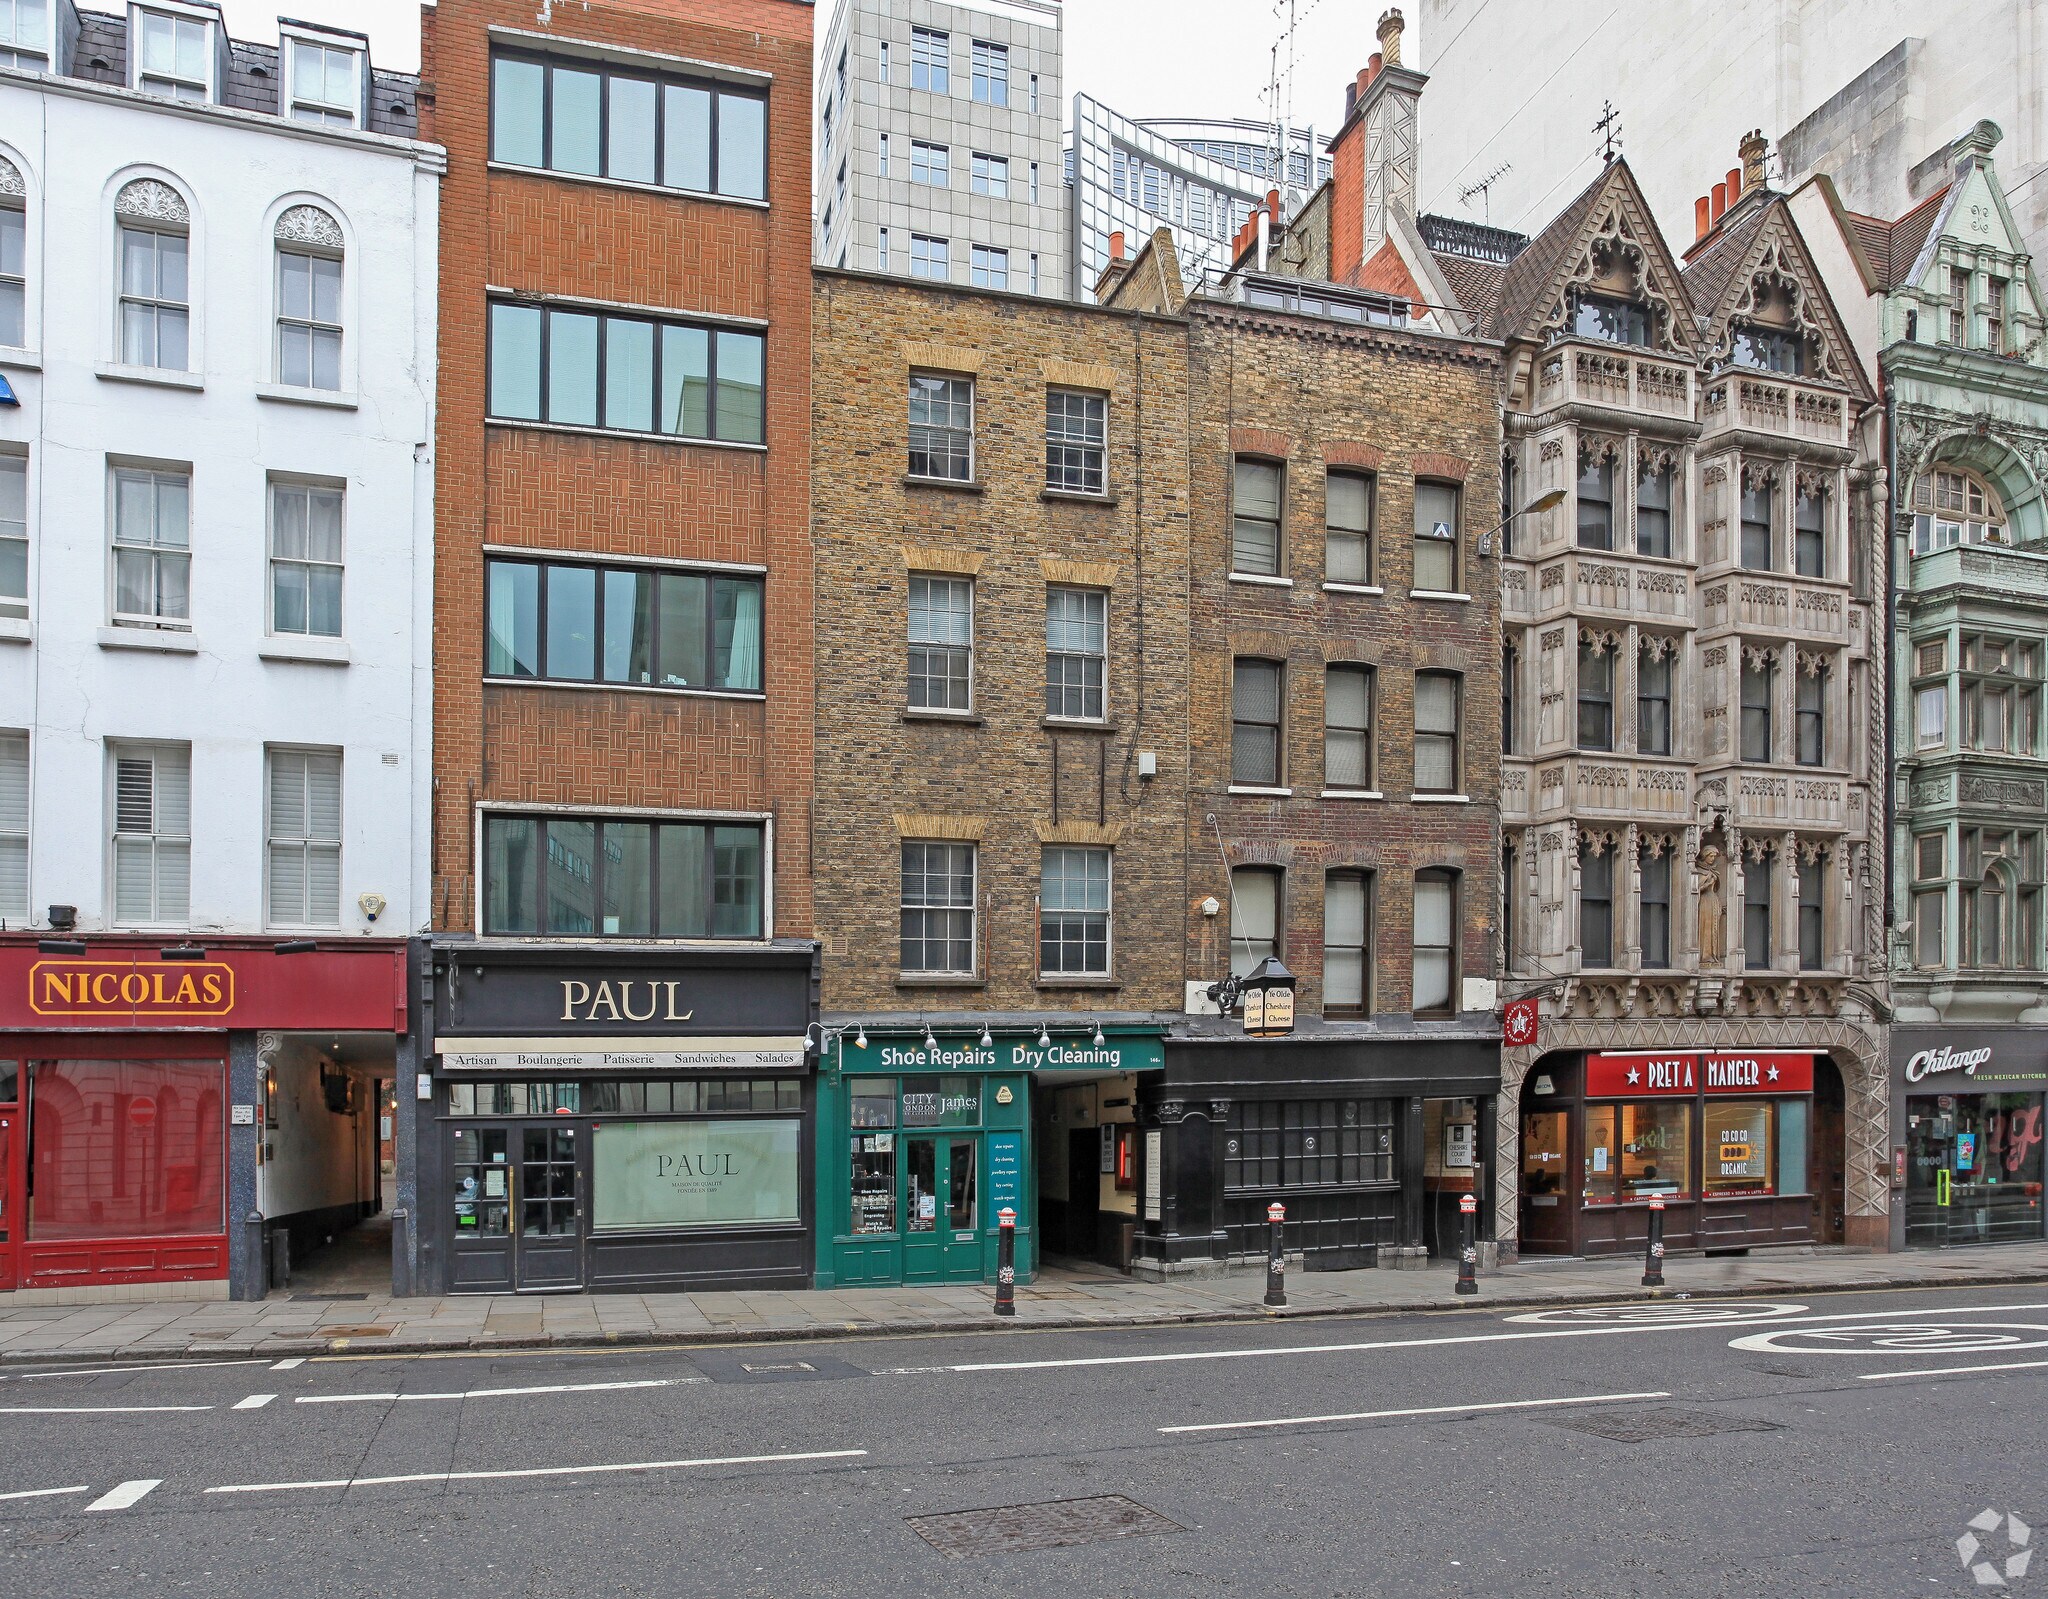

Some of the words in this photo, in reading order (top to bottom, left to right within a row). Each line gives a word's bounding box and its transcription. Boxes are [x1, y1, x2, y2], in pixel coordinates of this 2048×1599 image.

[43, 973, 222, 1004] NICOLAS
[560, 980, 694, 1020] PAUL
[1266, 1002, 1291, 1010] Cheshire
[455, 1055, 497, 1065] Artisan
[517, 1054, 583, 1066] Boulangerie
[603, 1053, 655, 1064] Patisserie
[674, 1053, 736, 1063] Sandwiches
[755, 1053, 794, 1063] Salades
[881, 1047, 926, 1065] Shoe
[930, 1048, 996, 1069] Repairs
[1012, 1047, 1044, 1068] Dry
[1047, 1047, 1120, 1067] Cleaning
[1905, 1045, 1991, 1082] Chilango
[1648, 1061, 1680, 1088] PRET
[1684, 1061, 1693, 1087] A
[1708, 1060, 1759, 1086] MANGER
[902, 1093, 934, 1104] CITY
[940, 1097, 977, 1114] James
[1721, 1130, 1730, 1142] GO
[1730, 1130, 1739, 1142] GO
[1740, 1130, 1748, 1141] GO
[656, 1153, 741, 1178] PAUL
[1721, 1163, 1747, 1175] ORGANIC
